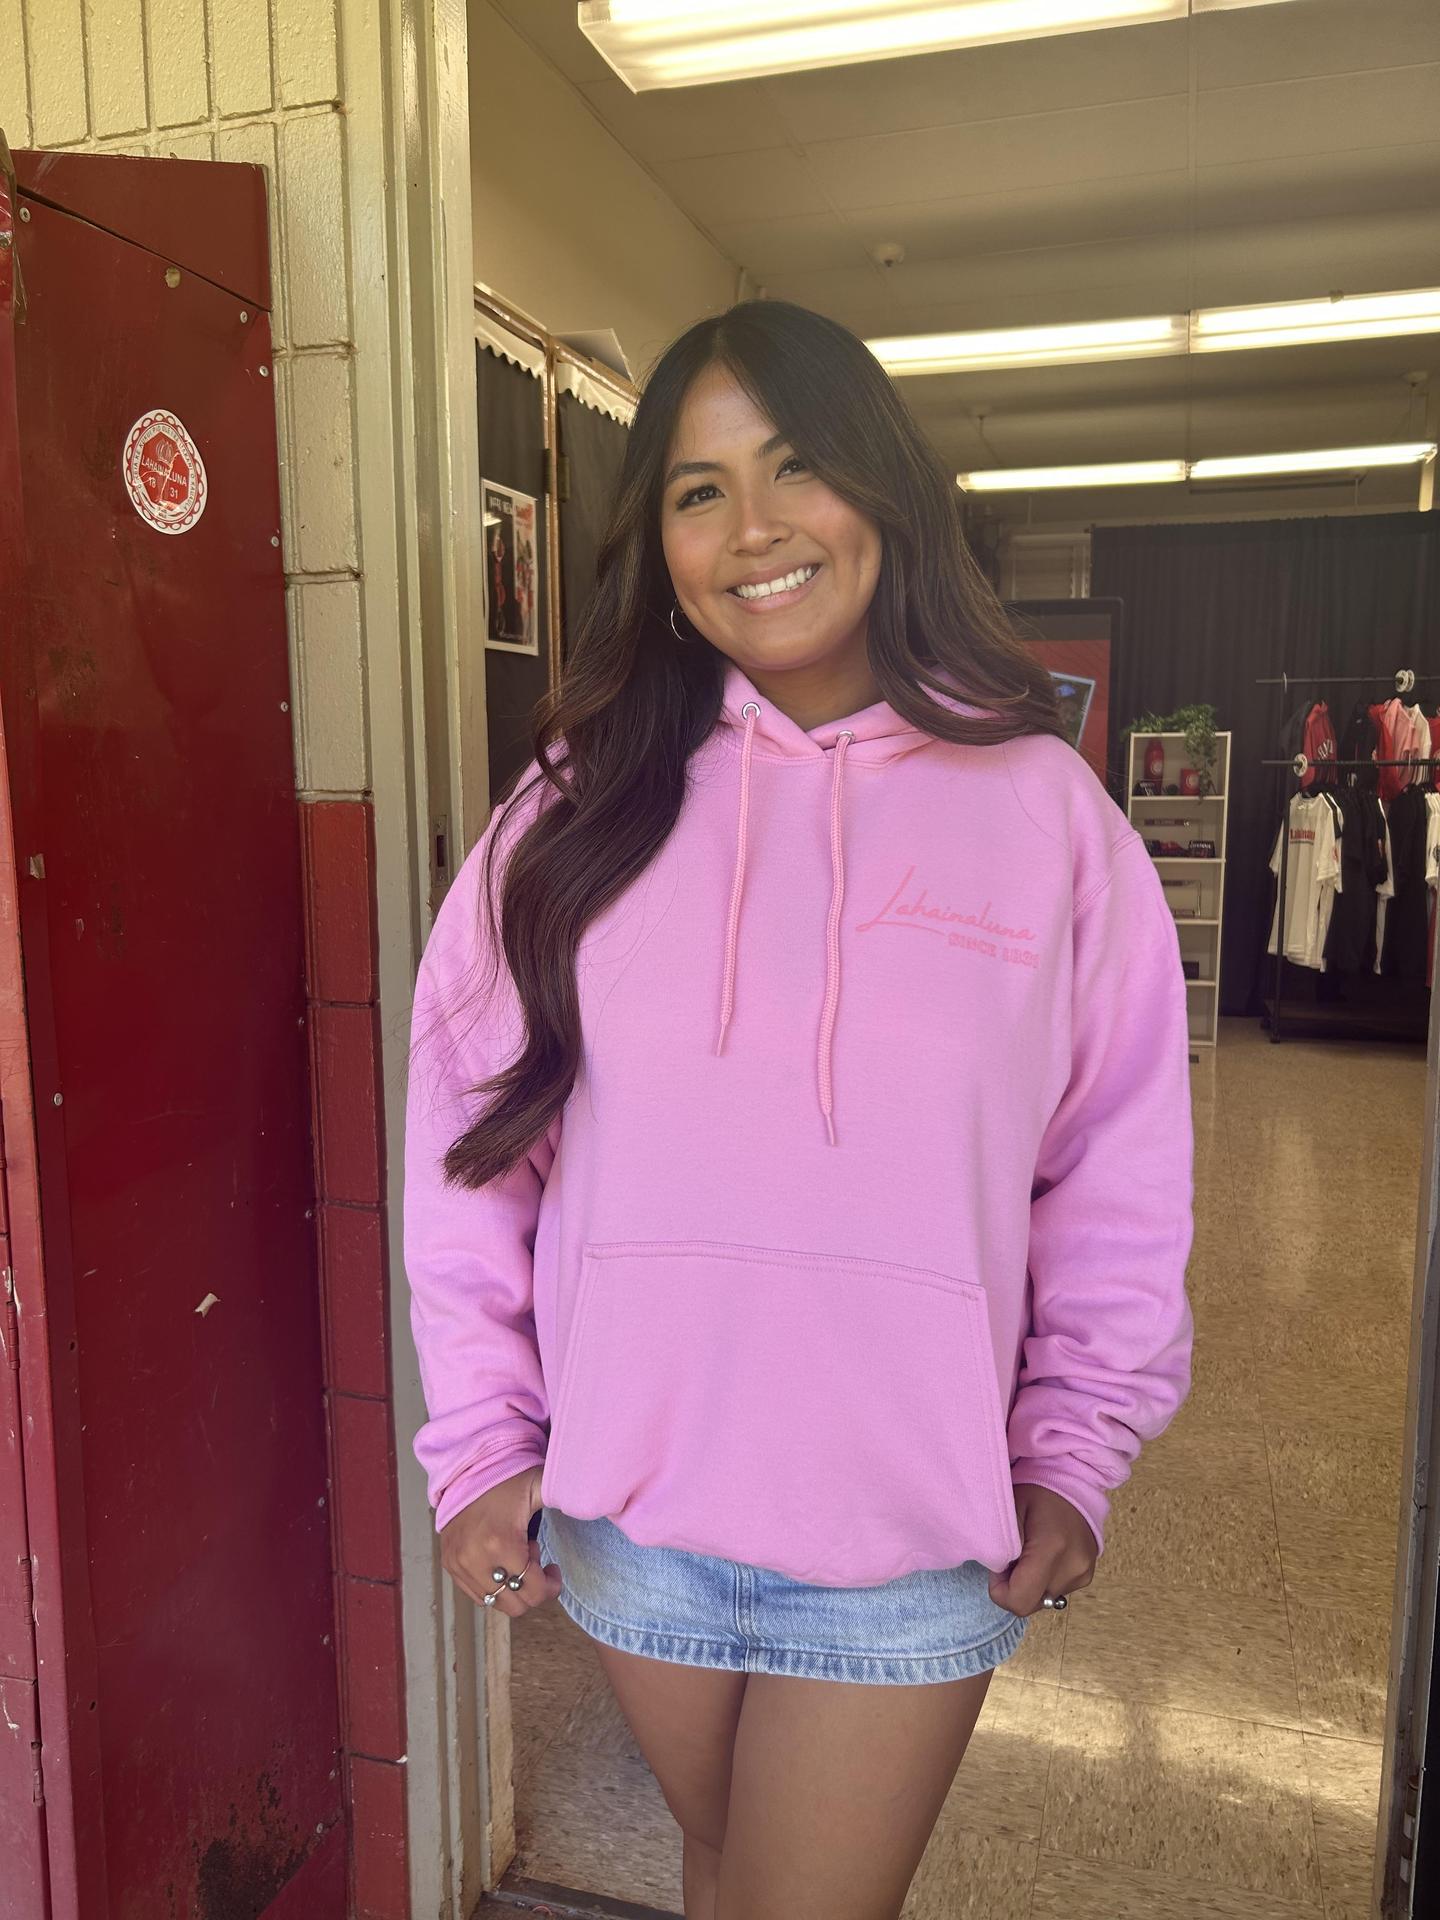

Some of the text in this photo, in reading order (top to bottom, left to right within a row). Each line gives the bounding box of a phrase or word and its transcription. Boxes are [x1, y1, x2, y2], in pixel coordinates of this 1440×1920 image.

[148, 476, 178, 499] 18 31
[947, 931, 997, 957] SINCE
